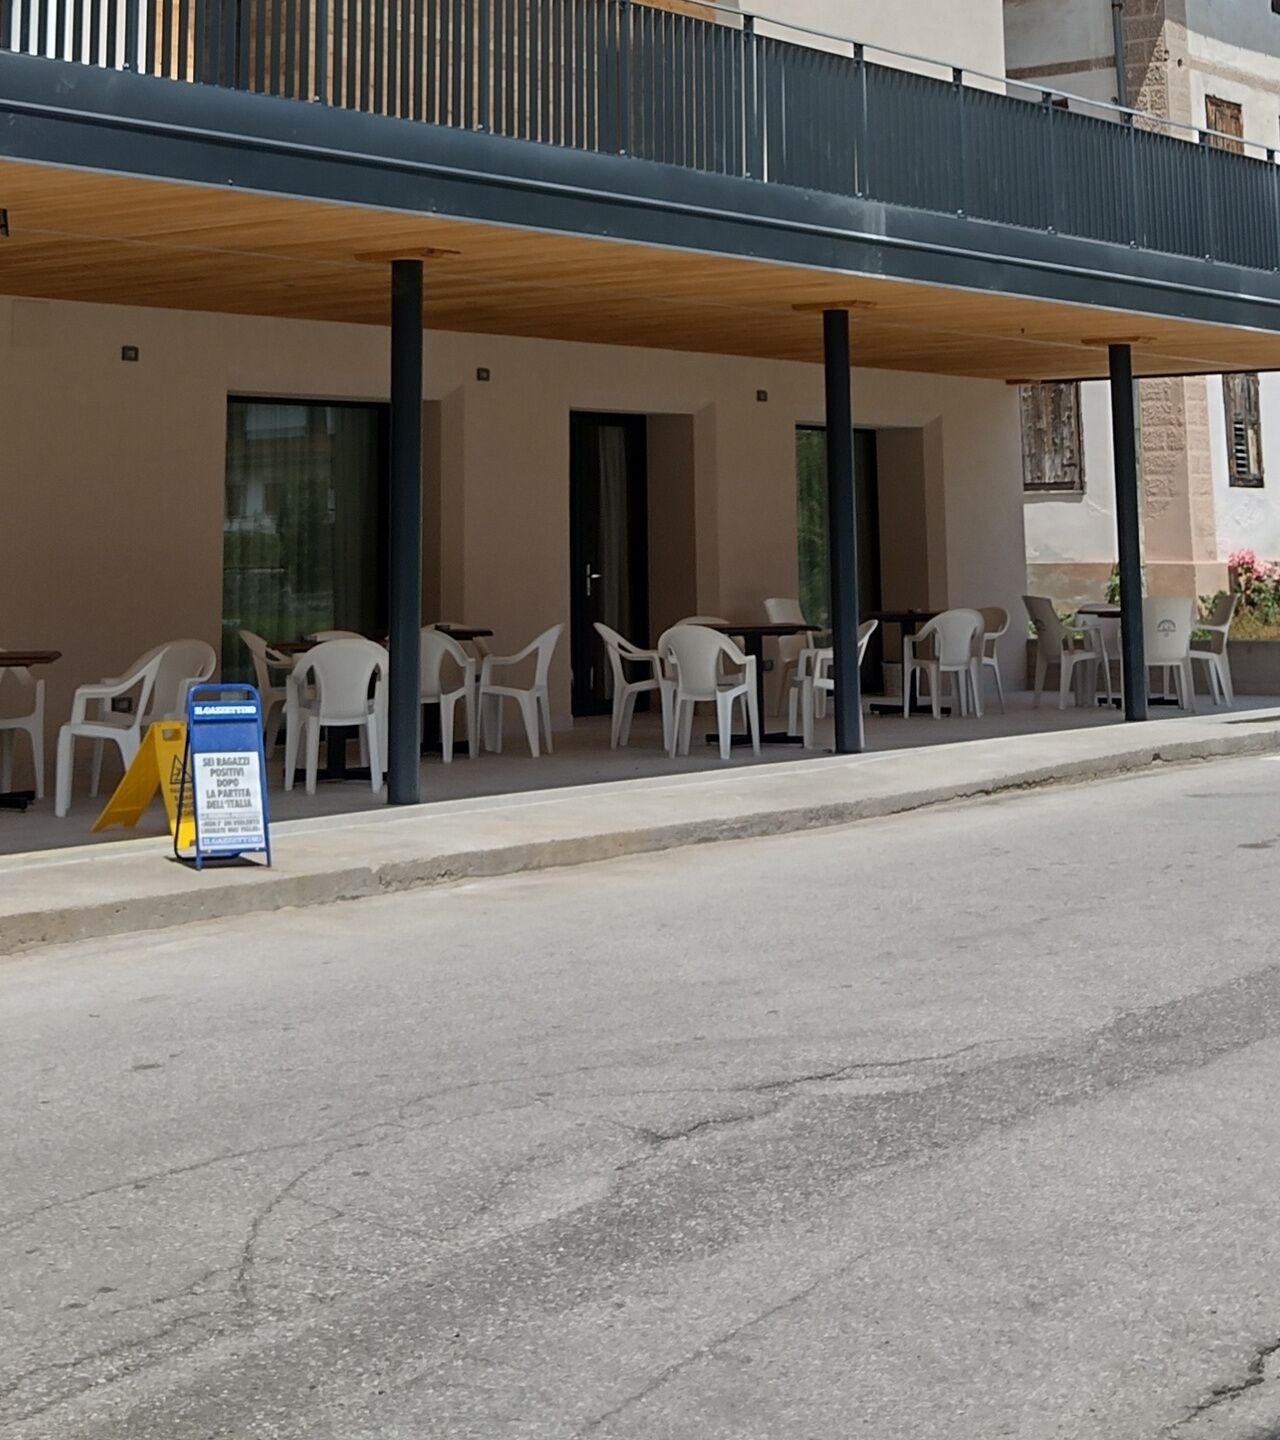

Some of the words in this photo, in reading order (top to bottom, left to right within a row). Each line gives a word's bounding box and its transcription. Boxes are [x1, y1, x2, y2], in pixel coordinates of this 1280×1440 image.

[202, 757, 215, 767] SEI
[216, 756, 250, 766] RAGAZZI
[210, 767, 245, 777] POSITIVI
[216, 778, 239, 788] DOPO
[206, 789, 216, 799] LA
[217, 787, 251, 798] PARTITA
[206, 799, 252, 810] DELL'ITALIA
